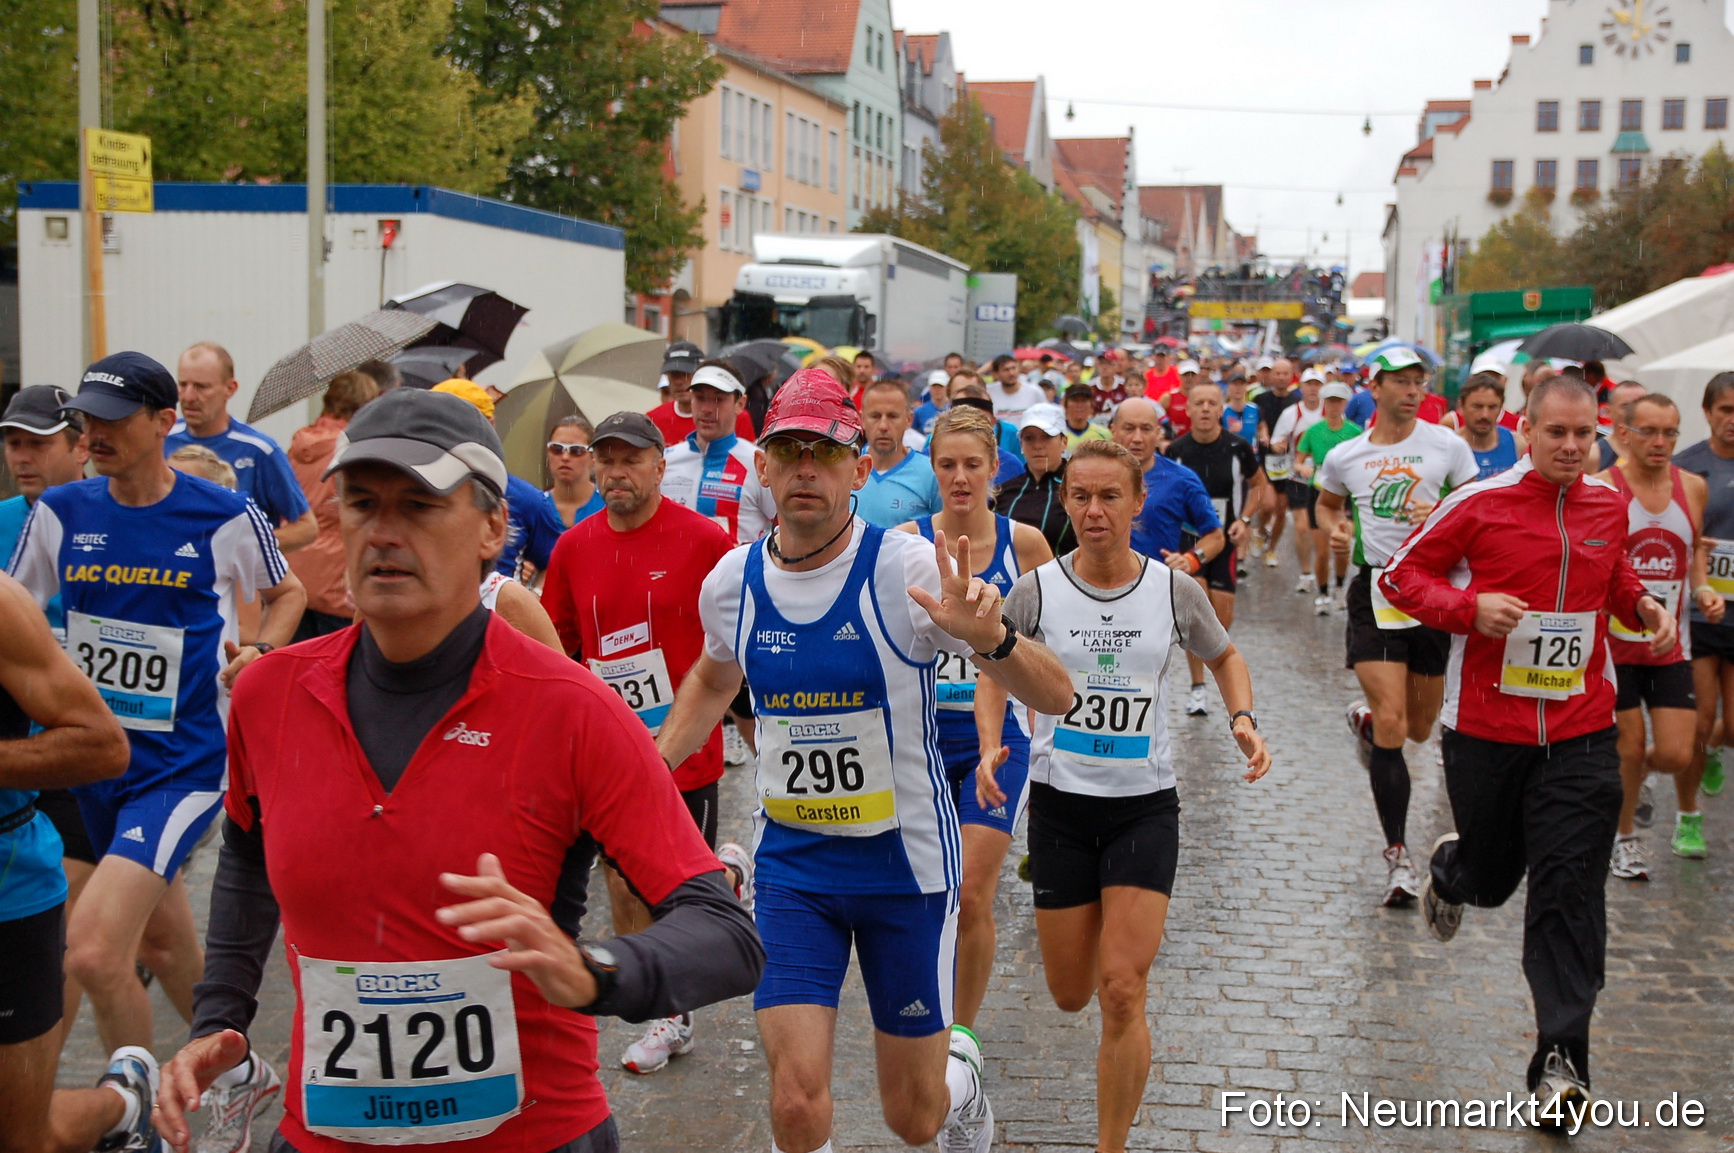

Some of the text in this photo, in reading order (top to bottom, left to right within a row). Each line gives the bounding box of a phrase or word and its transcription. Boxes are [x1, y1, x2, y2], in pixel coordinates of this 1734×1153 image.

[1403, 455, 1423, 464] run
[72, 533, 109, 545] HEITEC
[1633, 556, 1676, 571] LAC
[65, 564, 193, 588] LAC QUELLE
[99, 625, 146, 642] BOCK
[614, 632, 635, 646] DEHN
[756, 630, 797, 646] HEITEC
[832, 632, 860, 641] adidas
[1081, 629, 1142, 639] INTERSPORT
[1083, 638, 1132, 648] LANGE
[1528, 636, 1581, 667] 126
[77, 642, 169, 693] 3209
[937, 649, 980, 680] 21
[1087, 674, 1131, 687] BOCK
[764, 691, 864, 709] LAC QUELLE
[1063, 692, 1152, 732] 2307
[789, 723, 841, 737] BOCK
[1093, 739, 1114, 754] Evi
[781, 747, 865, 794] 296
[795, 804, 861, 821] Carsten
[356, 973, 441, 993] BOCK
[900, 1009, 930, 1017] adidas
[322, 1004, 495, 1080] 2120
[363, 1095, 458, 1124] Jürgen
